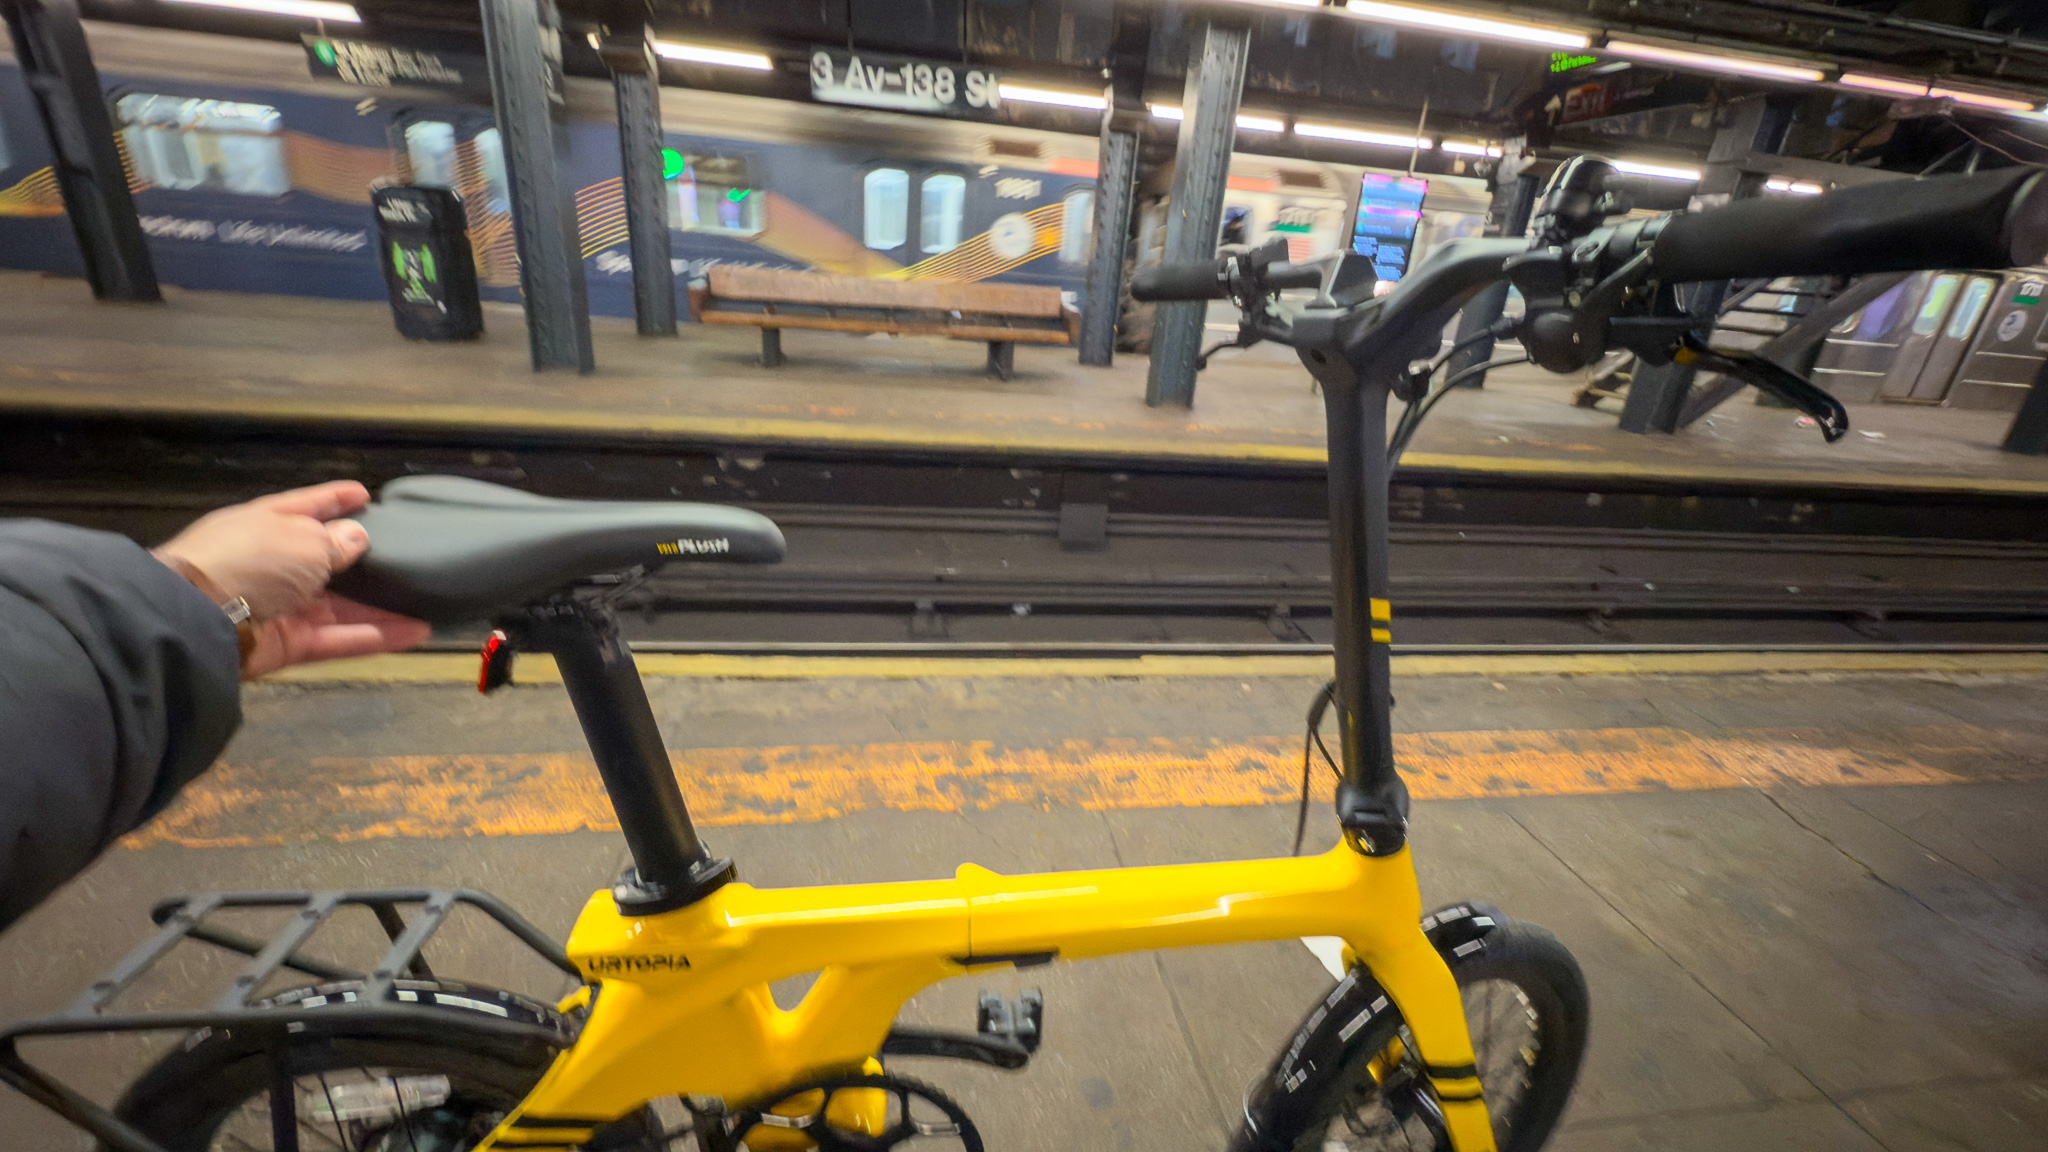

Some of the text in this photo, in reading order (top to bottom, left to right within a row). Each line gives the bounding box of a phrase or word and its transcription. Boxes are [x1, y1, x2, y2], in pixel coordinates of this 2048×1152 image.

[811, 51, 1001, 110] 3 Av-138 St
[588, 953, 692, 974] URTOPIA
